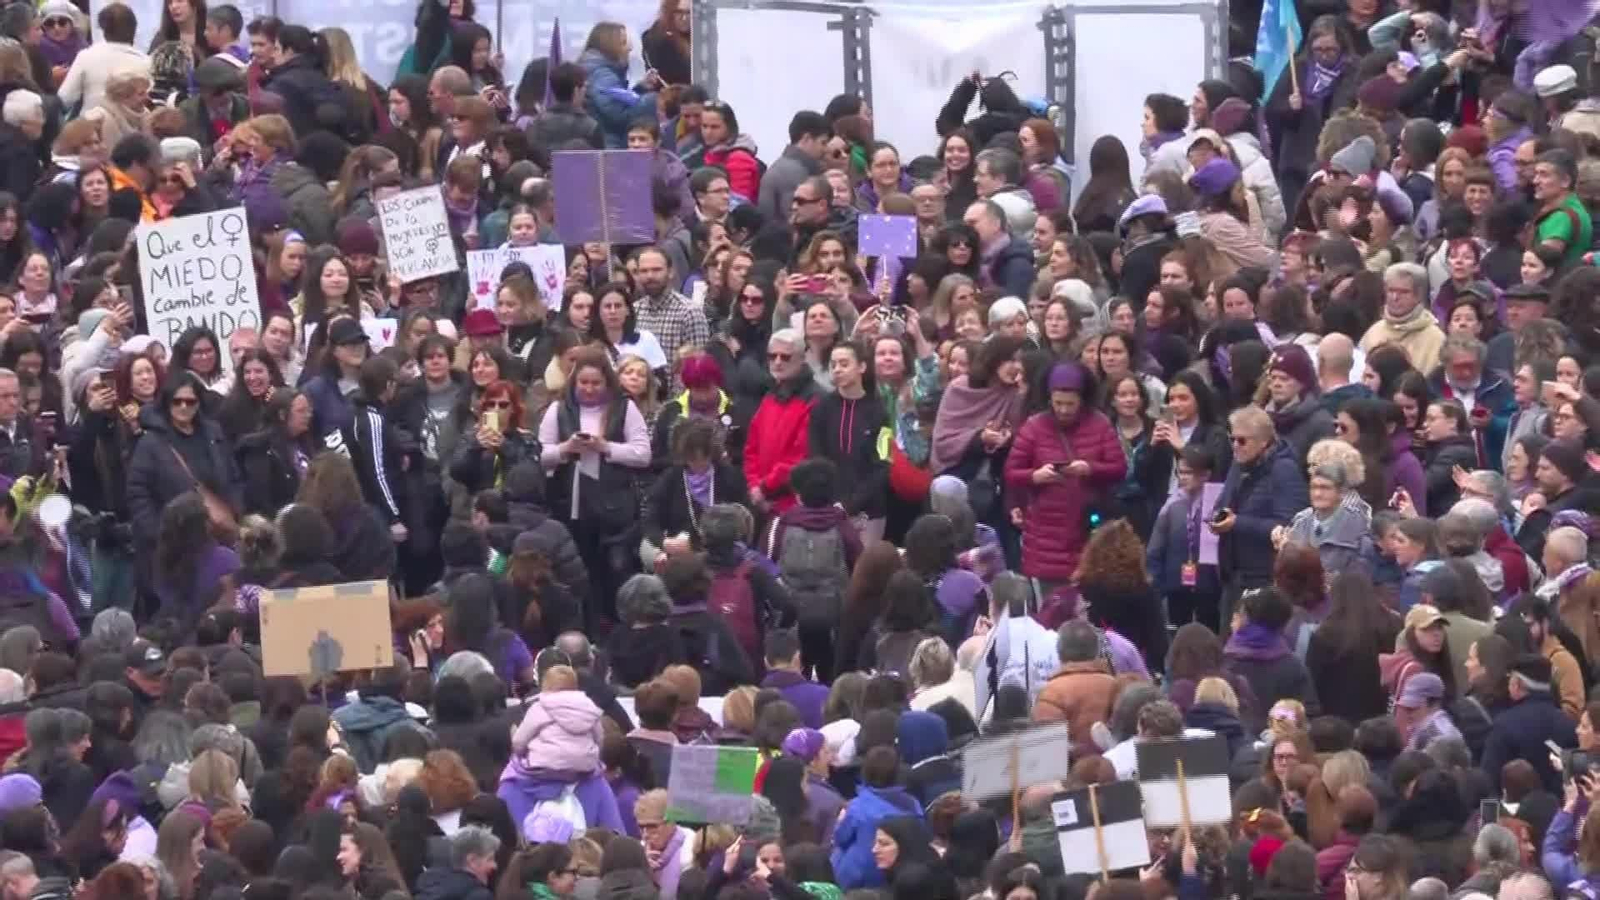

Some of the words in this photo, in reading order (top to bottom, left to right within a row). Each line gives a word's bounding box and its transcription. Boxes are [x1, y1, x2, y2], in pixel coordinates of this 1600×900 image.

[147, 230, 183, 259] Que
[192, 215, 217, 248] el
[150, 253, 243, 294] MIEDO
[153, 287, 214, 314] cambie
[225, 279, 251, 306] de
